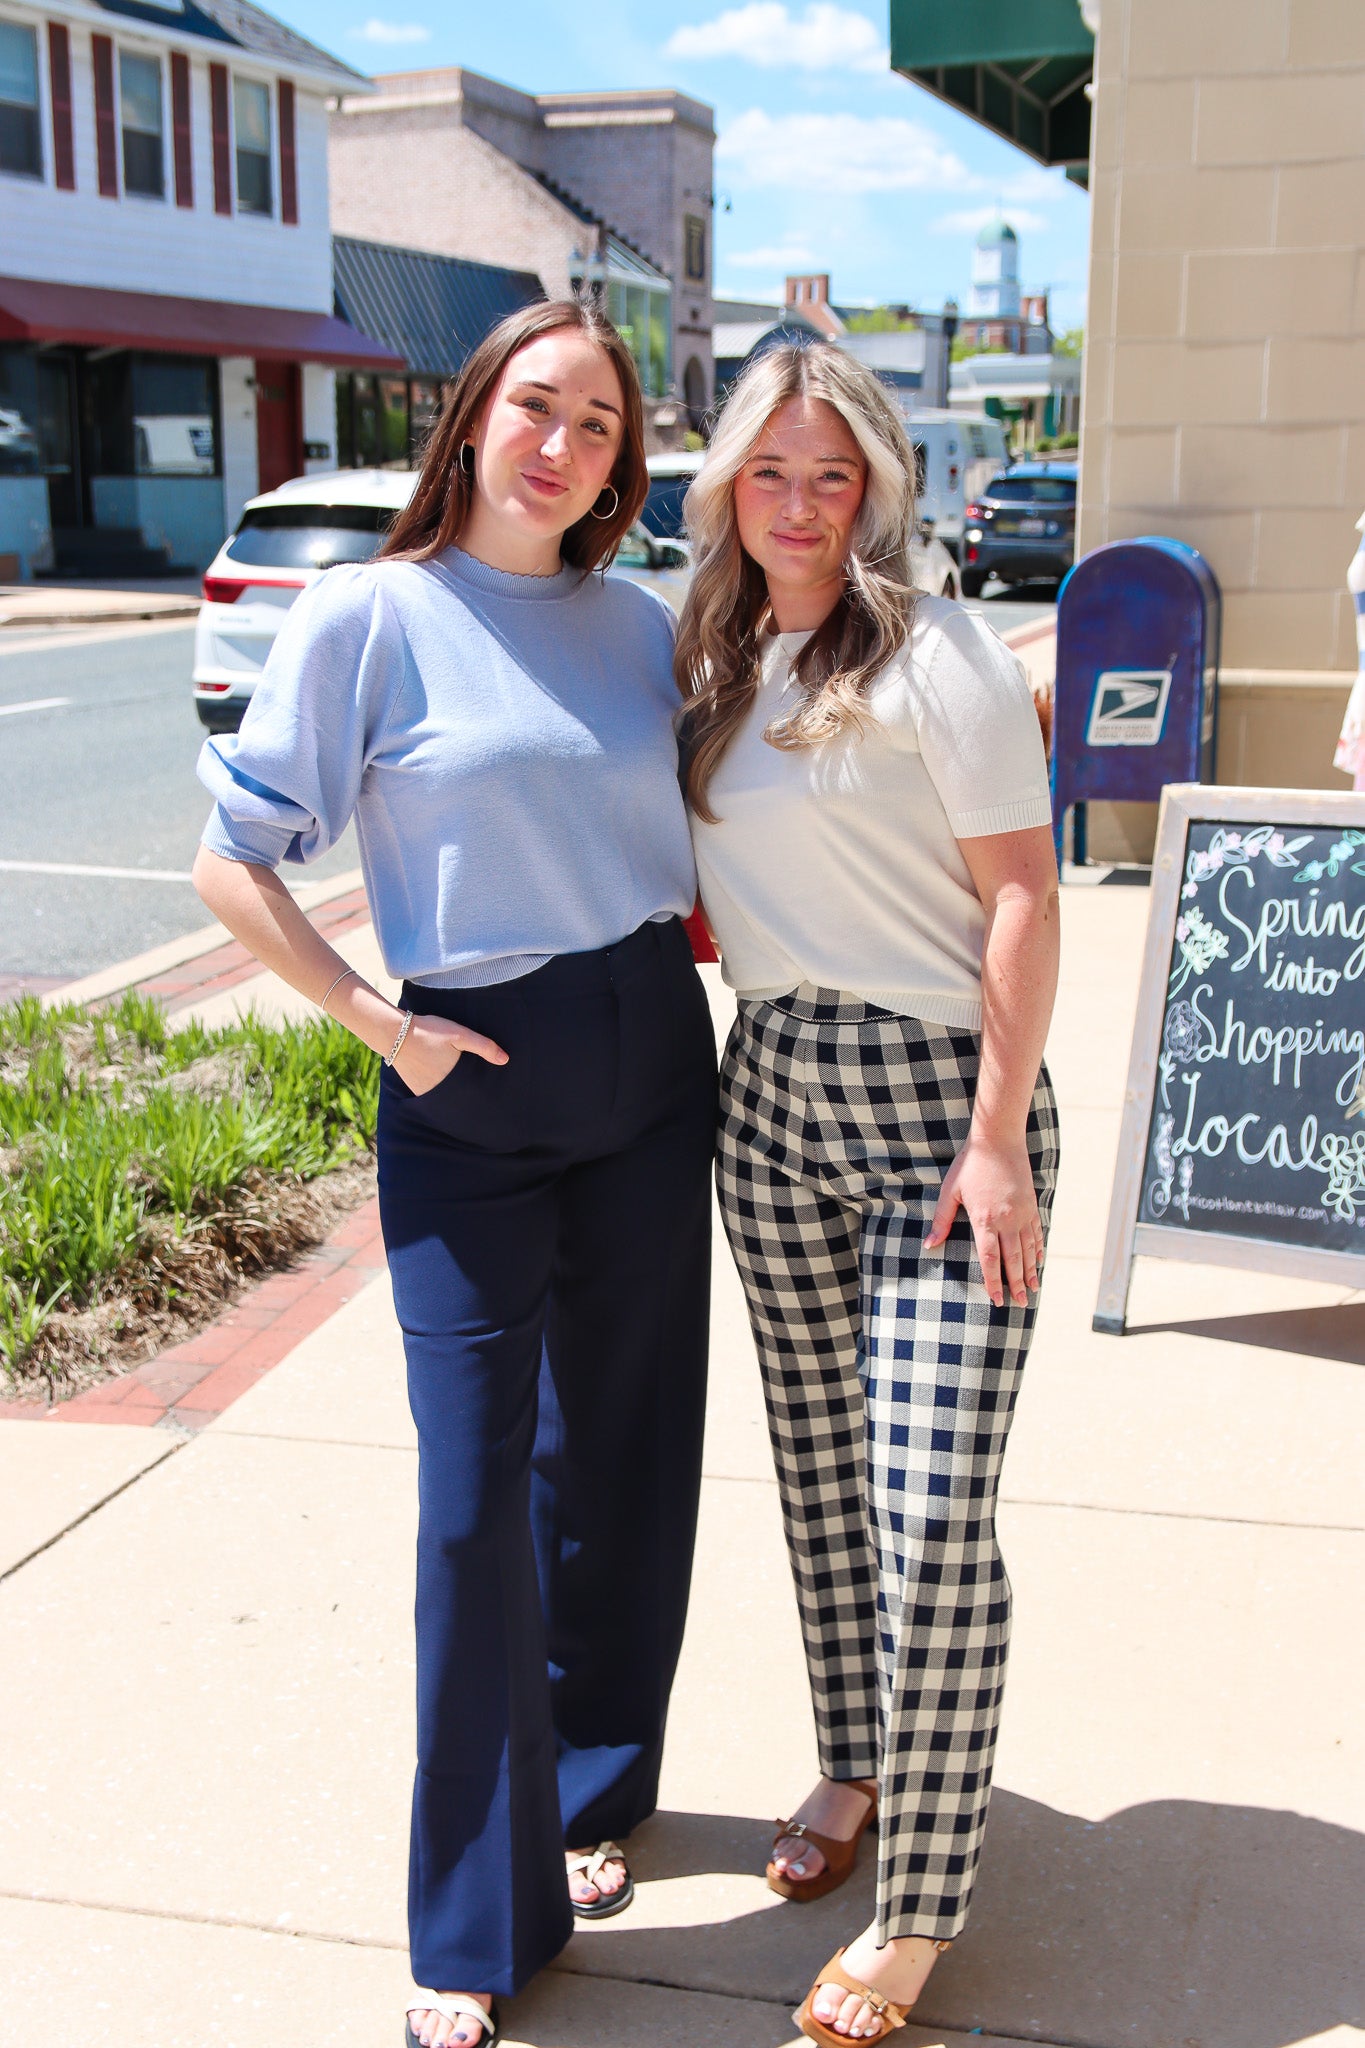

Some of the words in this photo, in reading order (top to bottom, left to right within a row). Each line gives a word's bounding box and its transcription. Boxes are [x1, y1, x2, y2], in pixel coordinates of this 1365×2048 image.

[1219, 866, 1365, 981] Spring
[1264, 952, 1341, 996] into
[1191, 984, 1365, 1106] Shopping
[1171, 1072, 1328, 1173] Local
